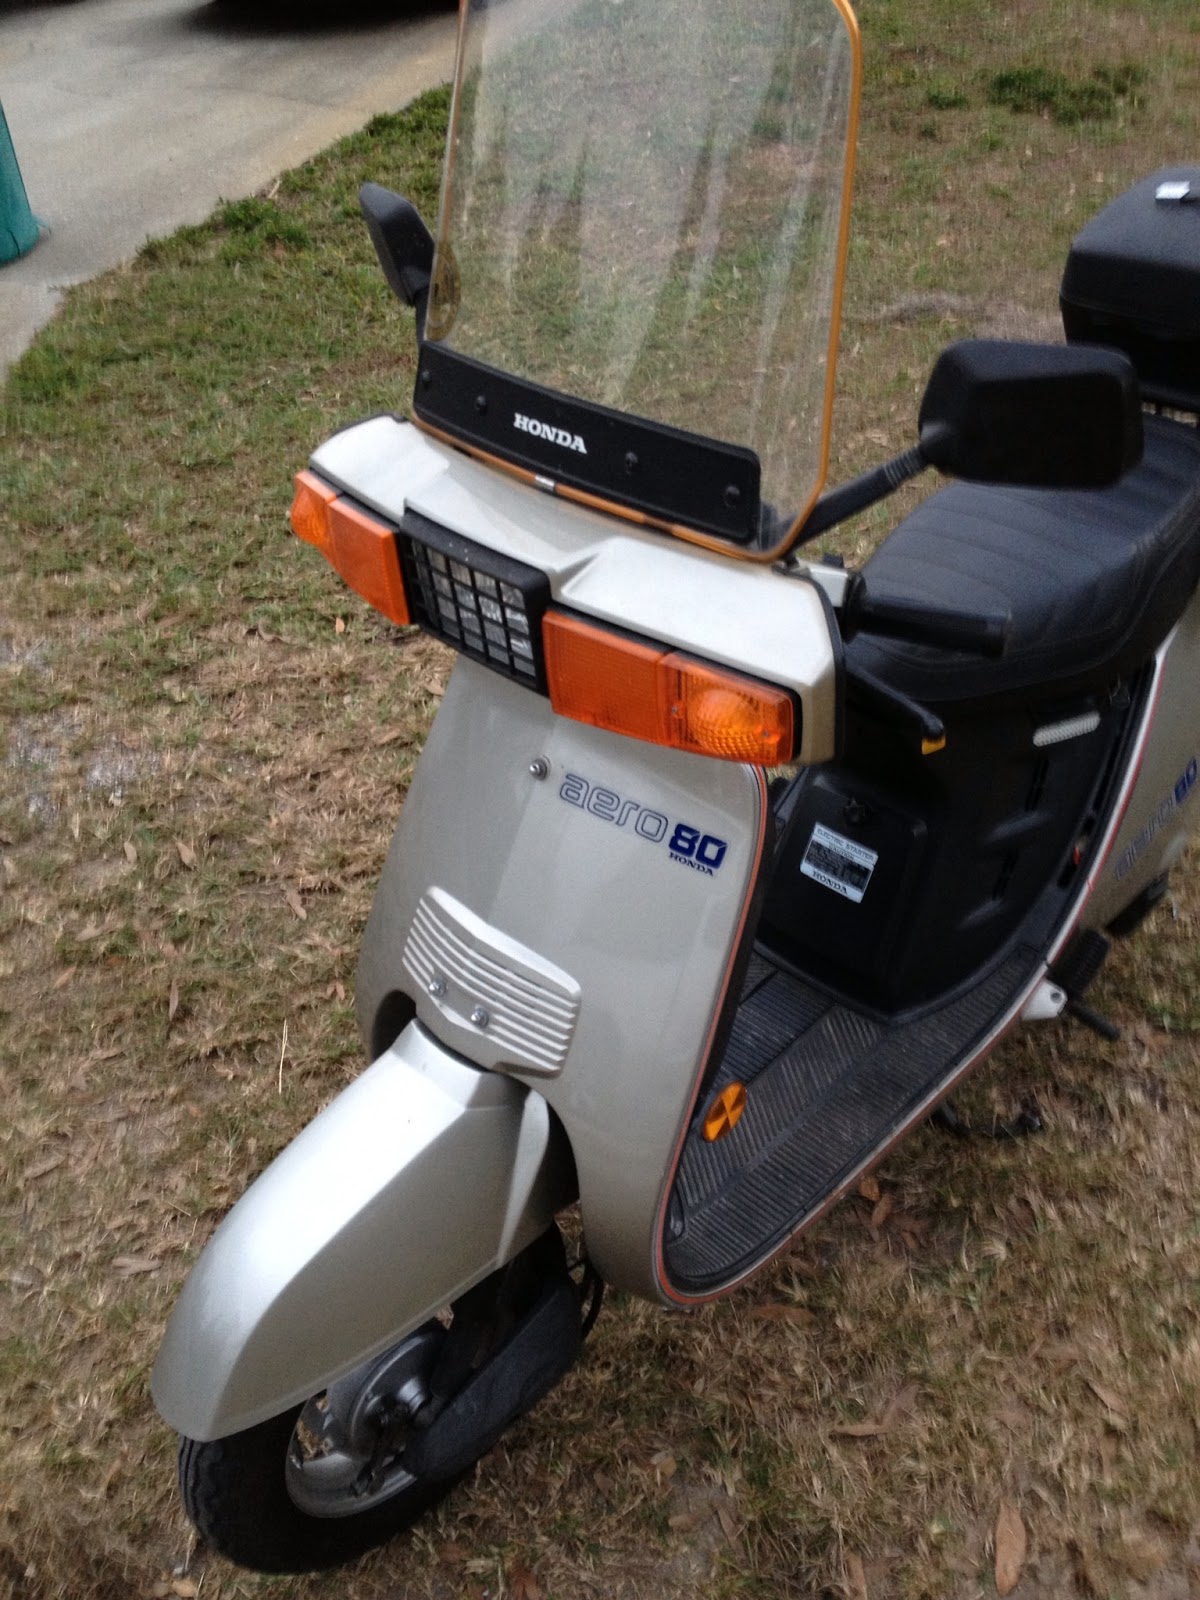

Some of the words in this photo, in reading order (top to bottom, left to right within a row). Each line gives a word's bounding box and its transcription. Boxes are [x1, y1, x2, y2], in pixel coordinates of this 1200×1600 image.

[513, 412, 587, 454] HONDA
[559, 773, 669, 843] aero
[668, 823, 728, 870] 80
[816, 827, 844, 847] ELECTRIC
[846, 843, 875, 862] STARTER
[669, 851, 715, 877] HONDA
[811, 870, 848, 895] HONDA
